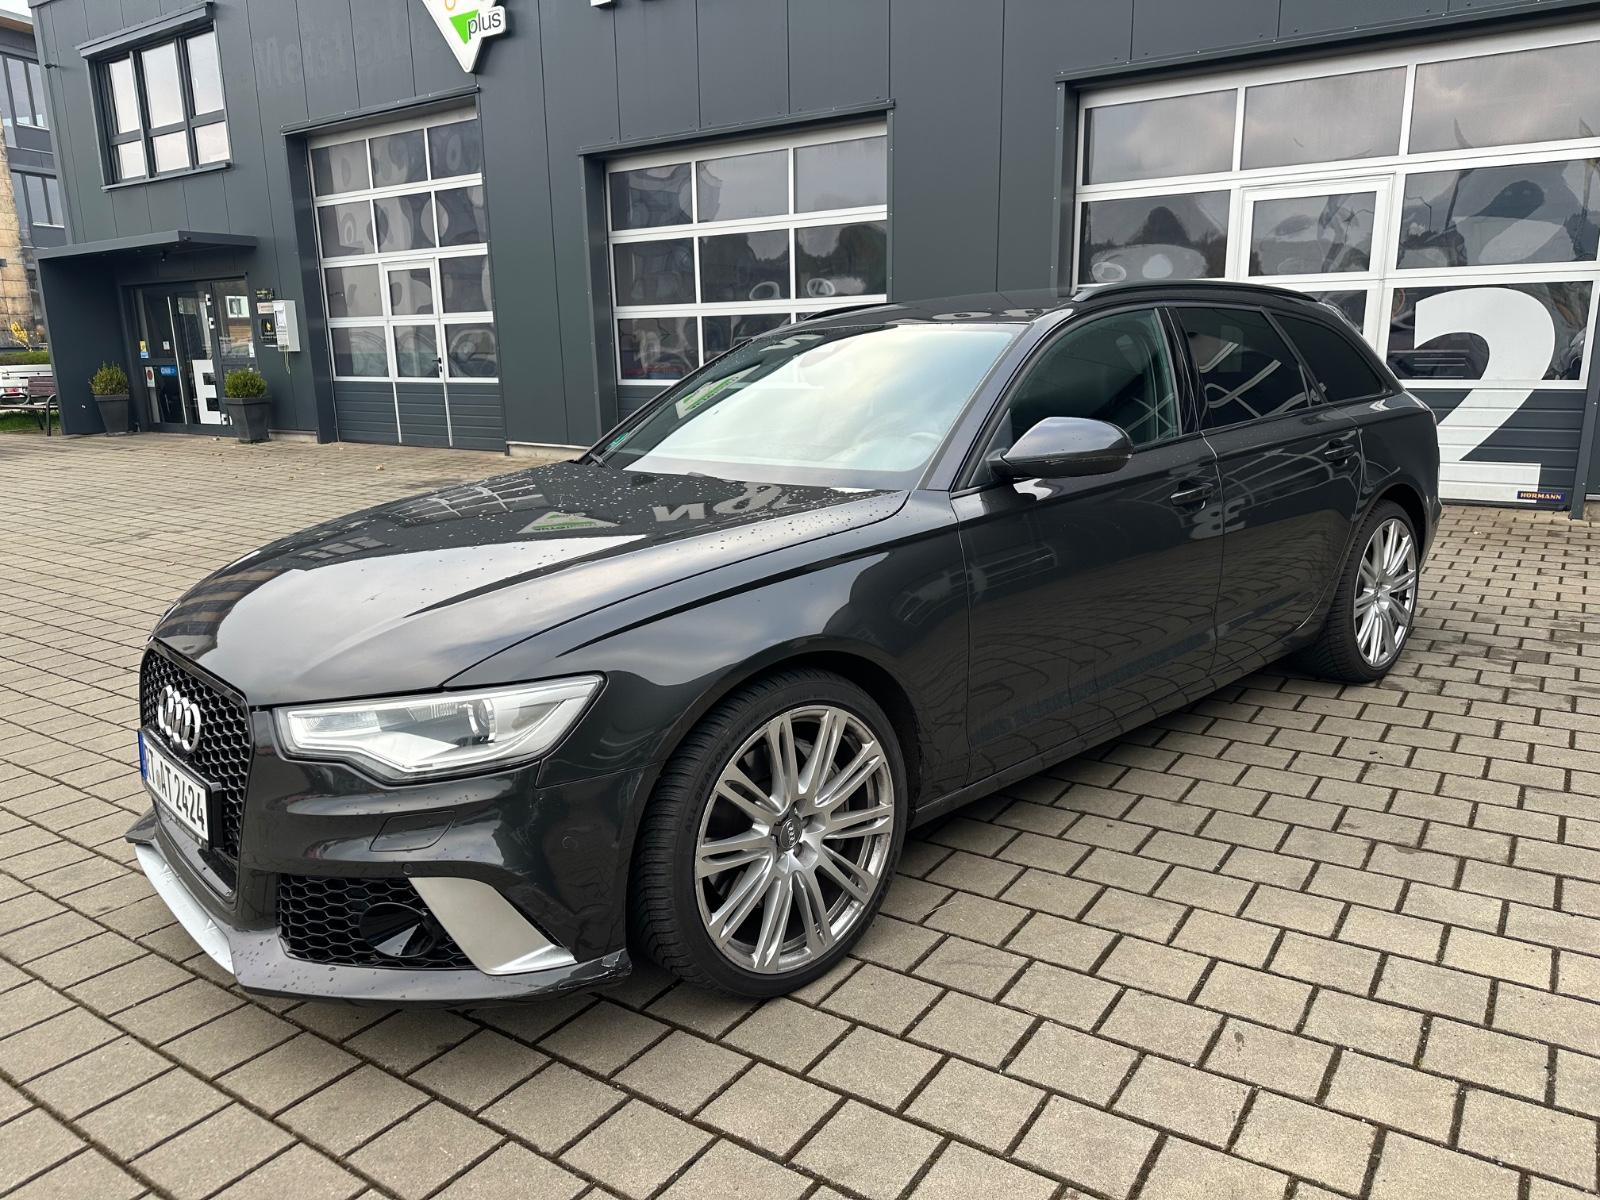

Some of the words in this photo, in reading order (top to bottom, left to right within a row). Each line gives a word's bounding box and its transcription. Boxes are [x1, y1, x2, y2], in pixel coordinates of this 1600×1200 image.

[468, 12, 501, 40] plus
[192, 359, 221, 425] E
[1414, 287, 1555, 503] 2
[160, 760, 172, 802] AT
[174, 773, 205, 832] 2424
